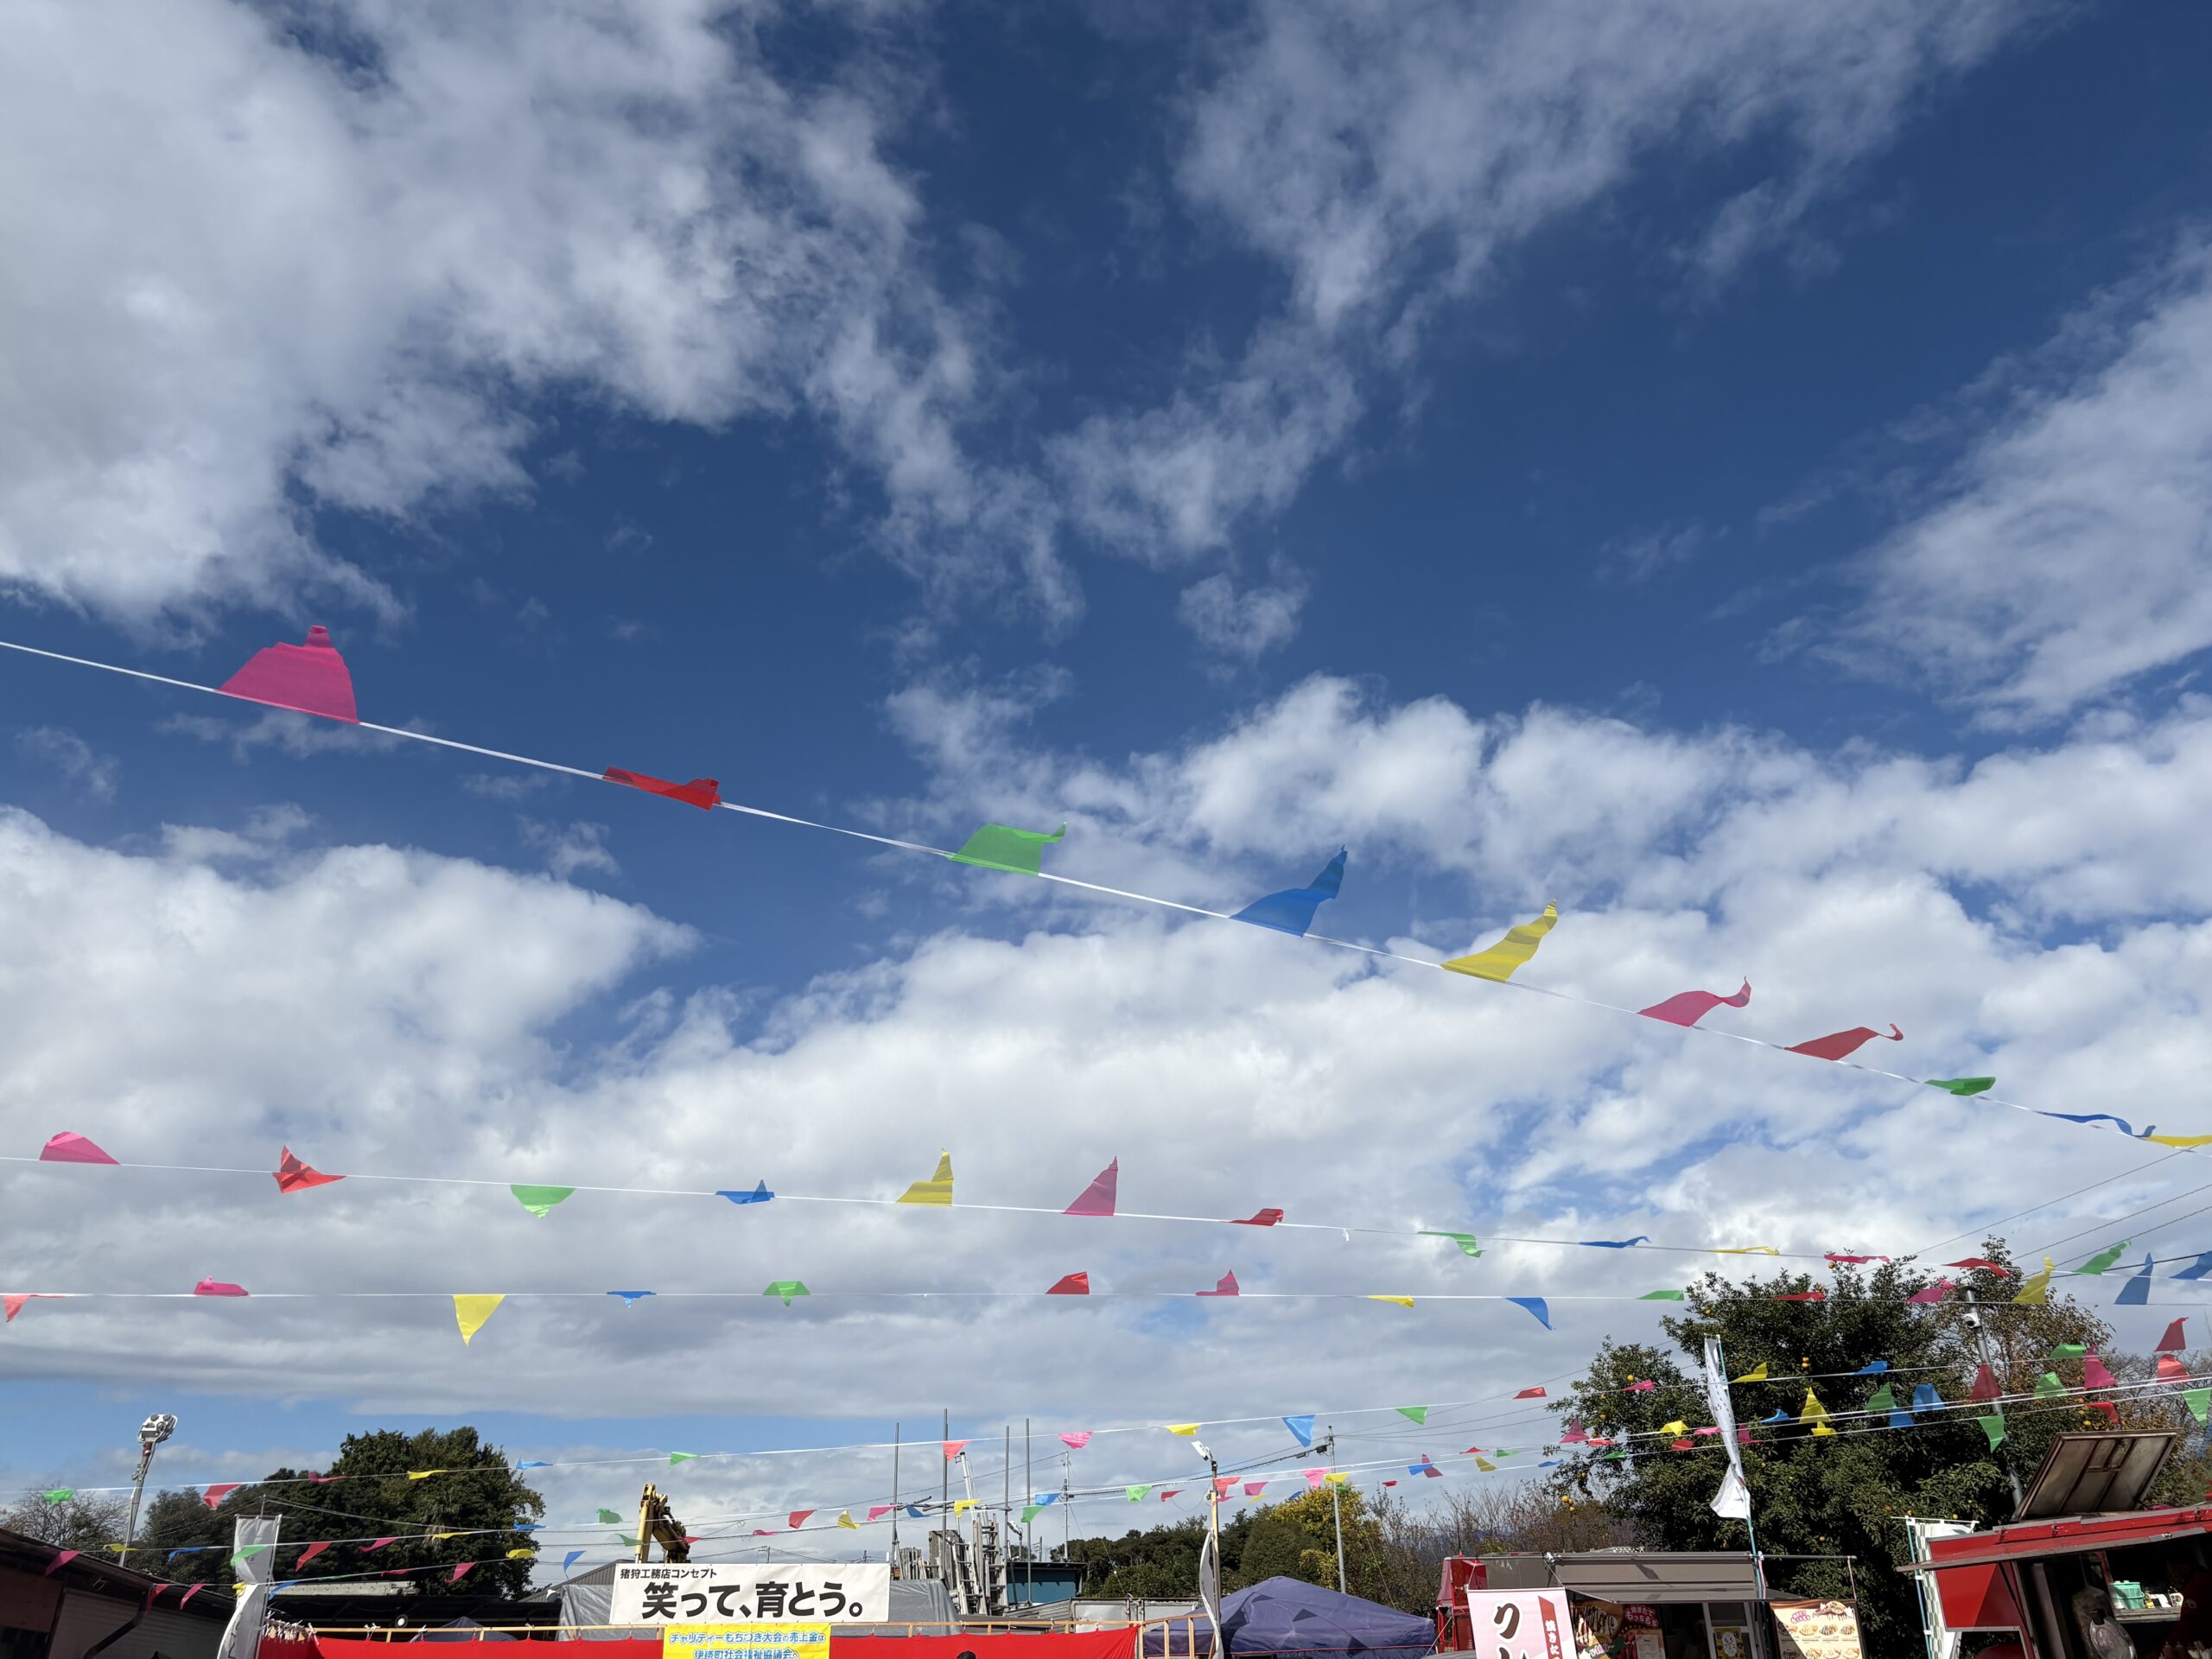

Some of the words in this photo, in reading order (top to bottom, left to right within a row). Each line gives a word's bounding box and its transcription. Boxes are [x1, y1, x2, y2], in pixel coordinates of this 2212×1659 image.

[620, 1568, 717, 1580] 猪狩工務店コンセプト
[641, 1581, 863, 1619] 笑って、育とう。
[670, 1630, 825, 1644] チャリティーもちつき大会の売上金は
